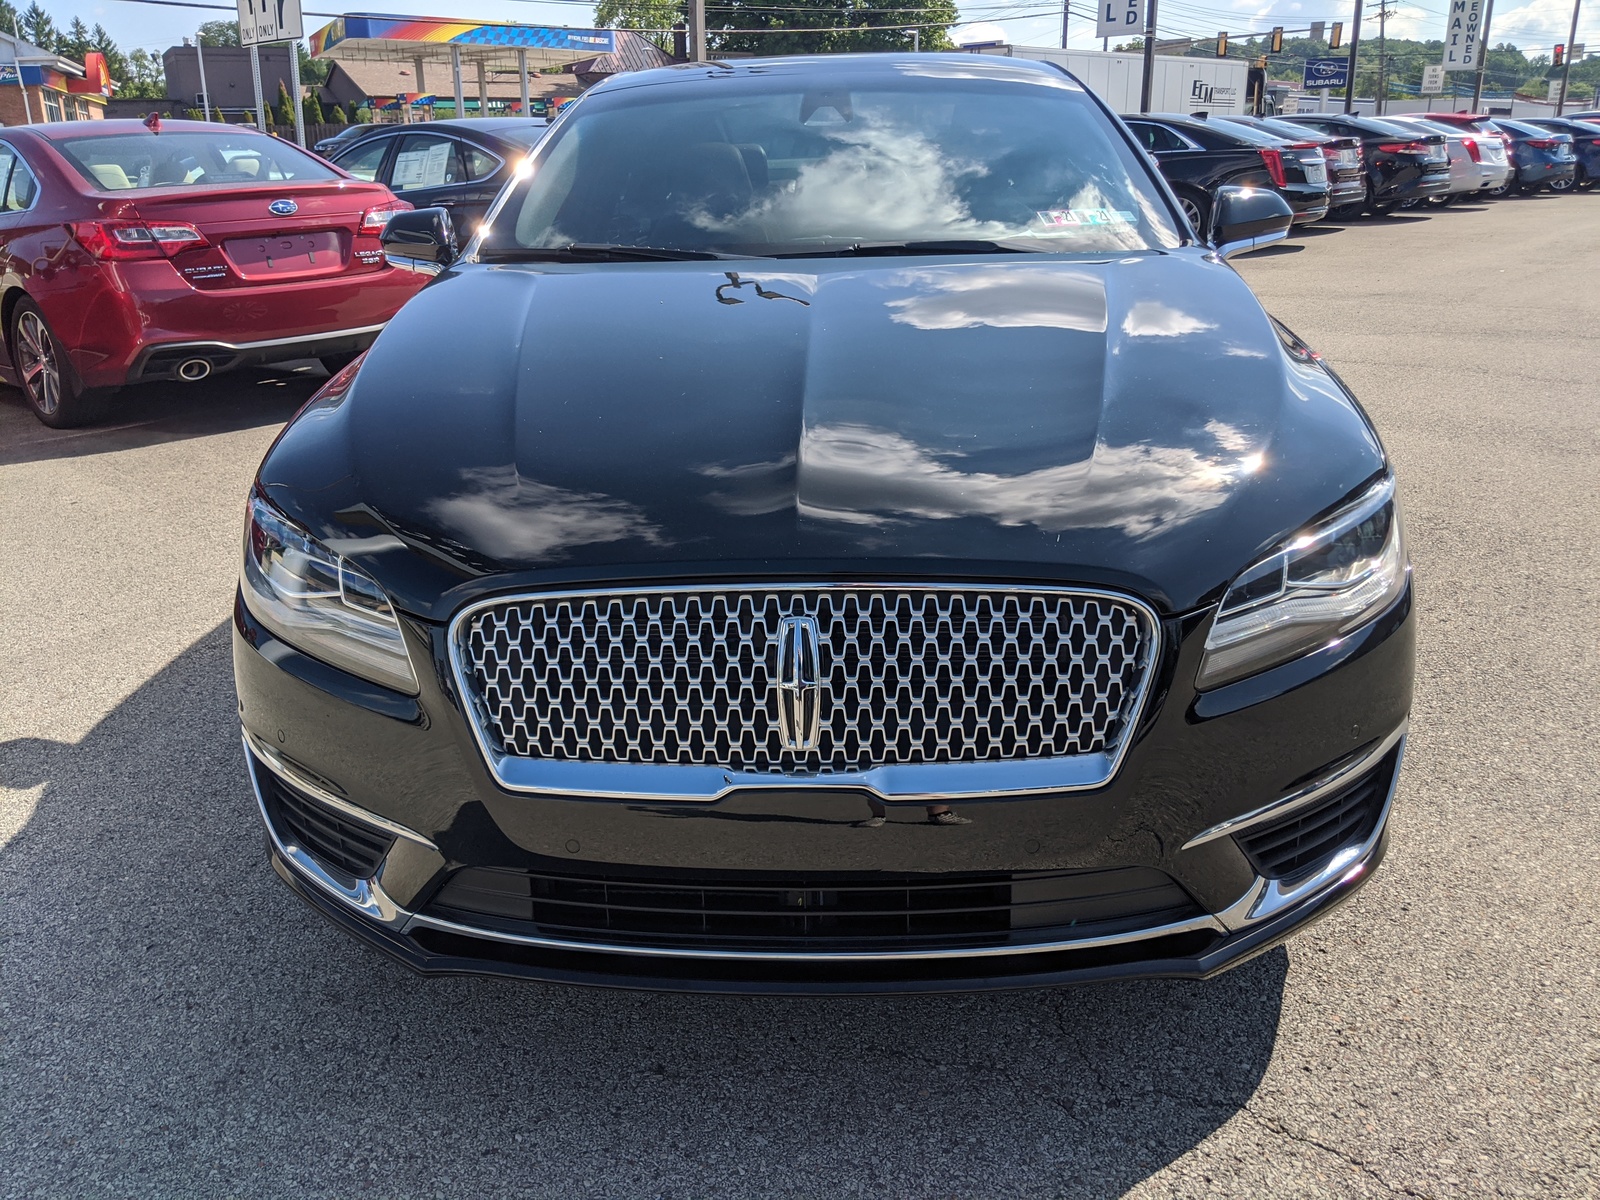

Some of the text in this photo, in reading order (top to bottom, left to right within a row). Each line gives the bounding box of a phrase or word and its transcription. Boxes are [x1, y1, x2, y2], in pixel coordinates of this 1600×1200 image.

[242, 26, 256, 41] ONLY
[258, 23, 274, 38] ONLY
[1448, 0, 1466, 63] MAIL
[1463, 1, 1479, 65] EOWNED
[1191, 80, 1214, 104] ECM
[1306, 79, 1344, 87] SUBARU
